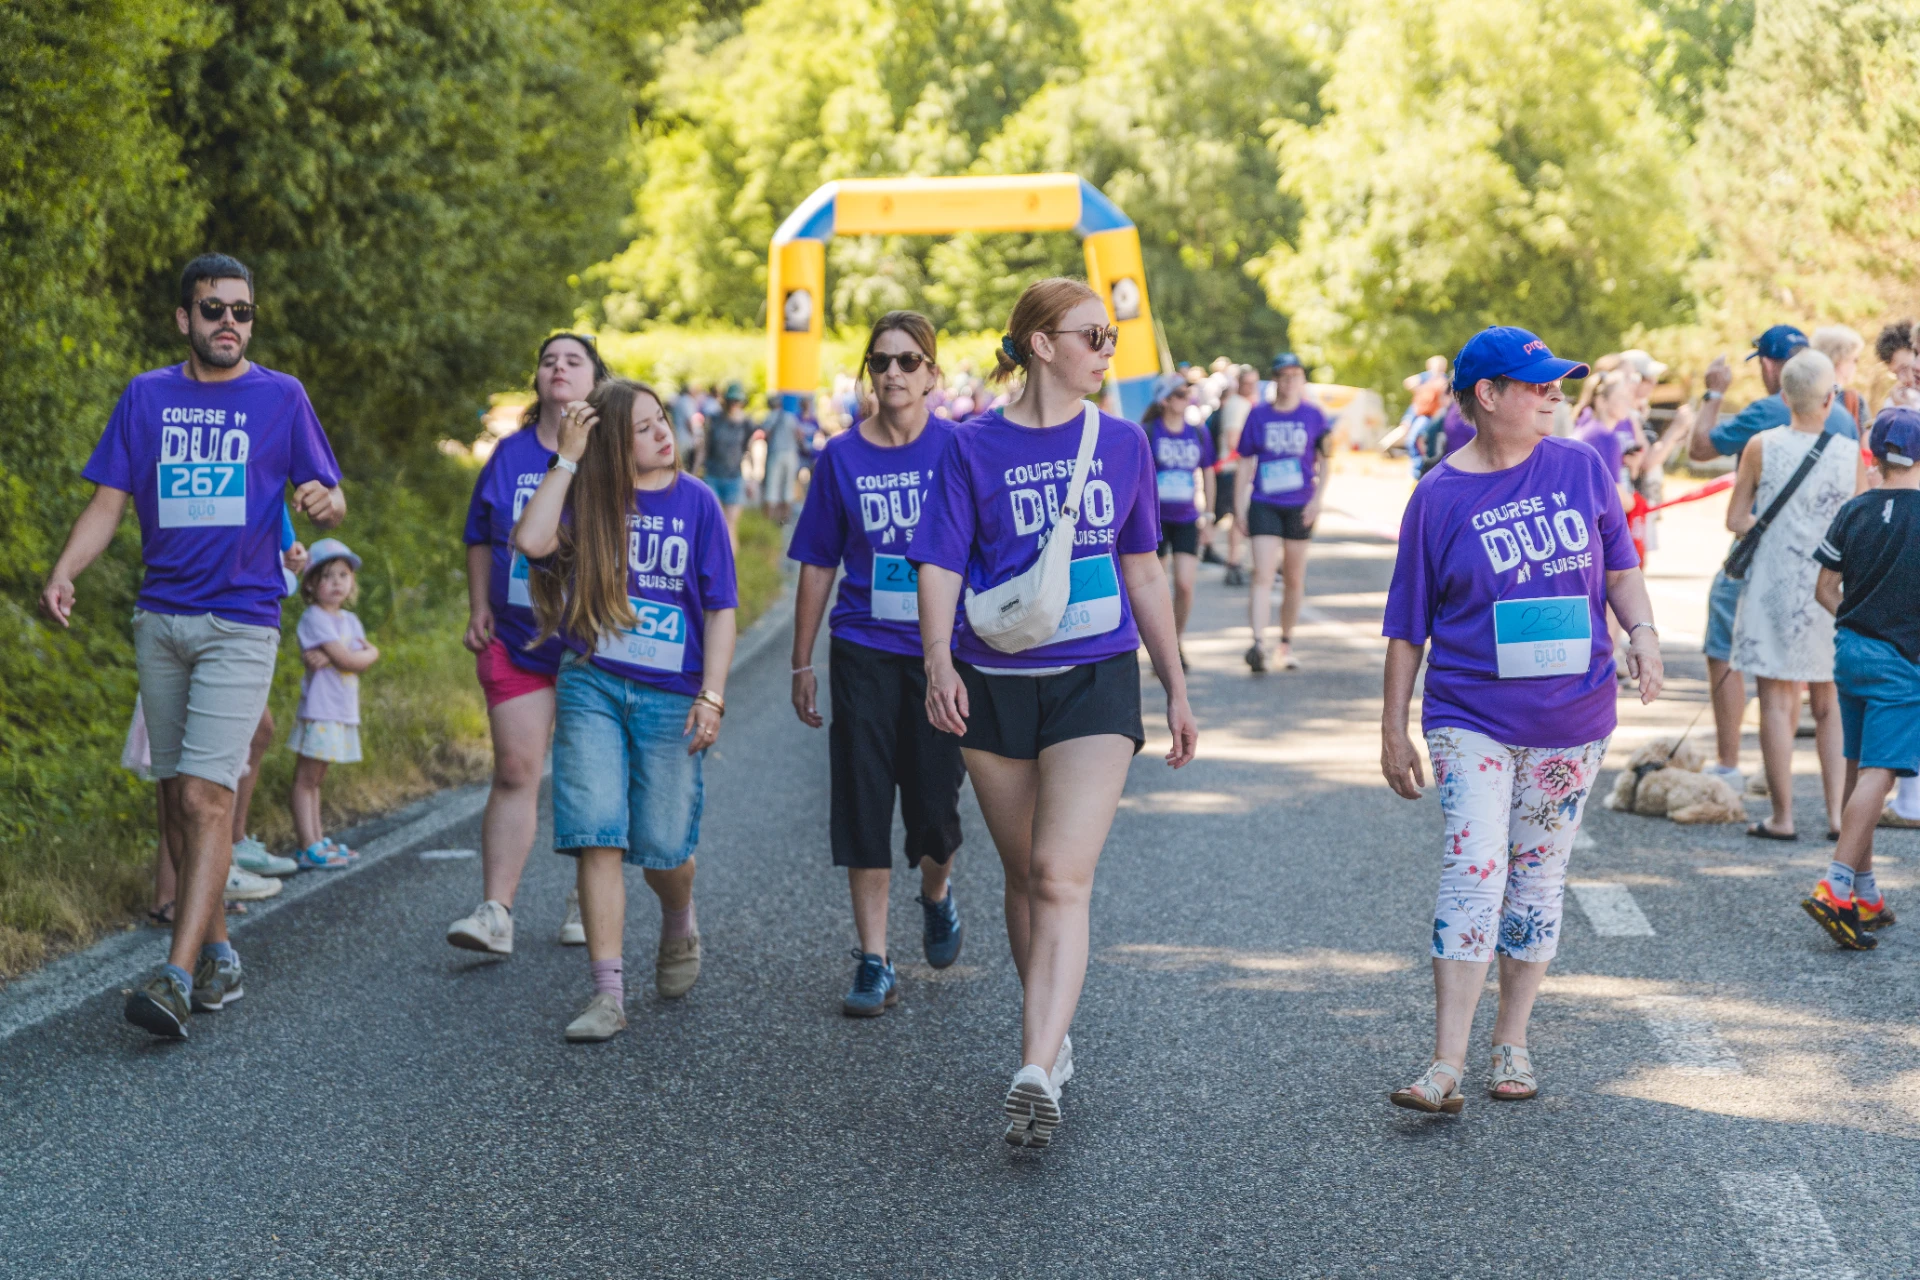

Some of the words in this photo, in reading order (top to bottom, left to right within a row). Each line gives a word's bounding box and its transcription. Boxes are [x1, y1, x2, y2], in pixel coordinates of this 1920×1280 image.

[1523, 340, 1547, 355] pro
[162, 407, 226, 425] COURSE
[161, 426, 250, 463] DUO
[171, 467, 234, 496] 267
[517, 472, 546, 486] COU
[856, 470, 920, 490] COURSE
[1004, 459, 1077, 486] COURSE
[188, 504, 216, 517] DUO
[860, 488, 928, 532] DU
[1472, 496, 1546, 531] COURSE
[627, 514, 664, 531] RSE
[1074, 528, 1115, 545] UISSE
[1480, 509, 1589, 575] DUO
[628, 531, 688, 576] UO
[1542, 552, 1593, 577] SUISSE
[638, 574, 684, 591] SUISSE
[887, 563, 918, 583] 26
[1070, 564, 1102, 594] 31
[628, 602, 679, 641] 64
[1521, 605, 1576, 635] 231
[628, 642, 656, 658] DUO
[1534, 648, 1567, 663] DUO
